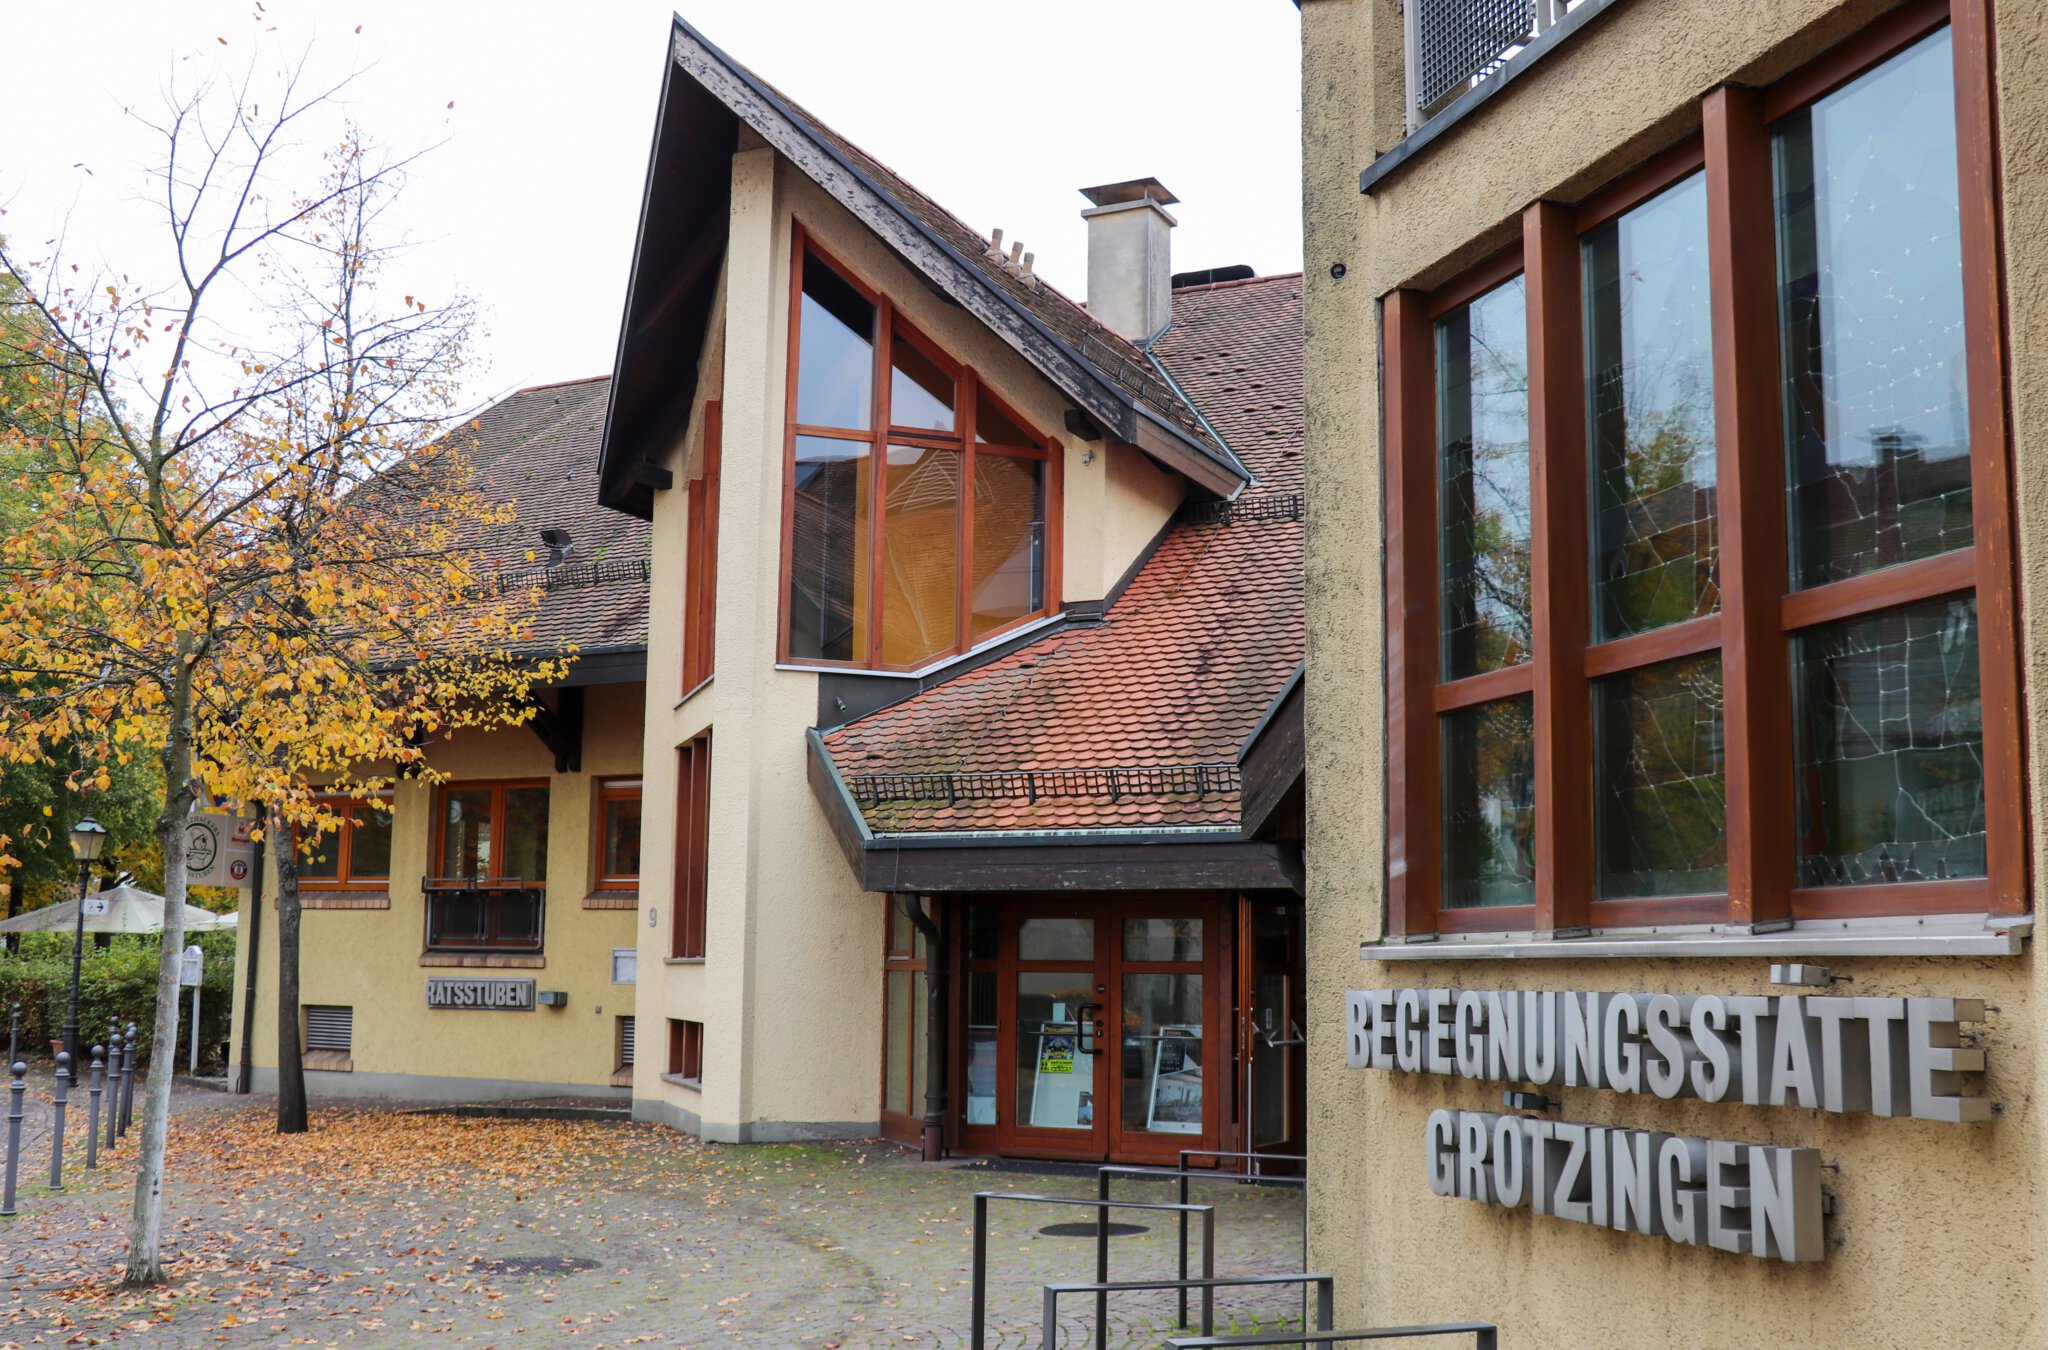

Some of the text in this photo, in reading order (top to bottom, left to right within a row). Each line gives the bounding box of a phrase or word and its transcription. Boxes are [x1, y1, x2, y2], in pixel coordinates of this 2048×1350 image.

[648, 906, 658, 928] 9
[427, 980, 529, 1007] RATSSTUBEN
[1345, 965, 1990, 1122] BEGEGNUNGSSTÄTTE
[1426, 1091, 1824, 1263] GRÖTZINGEN
